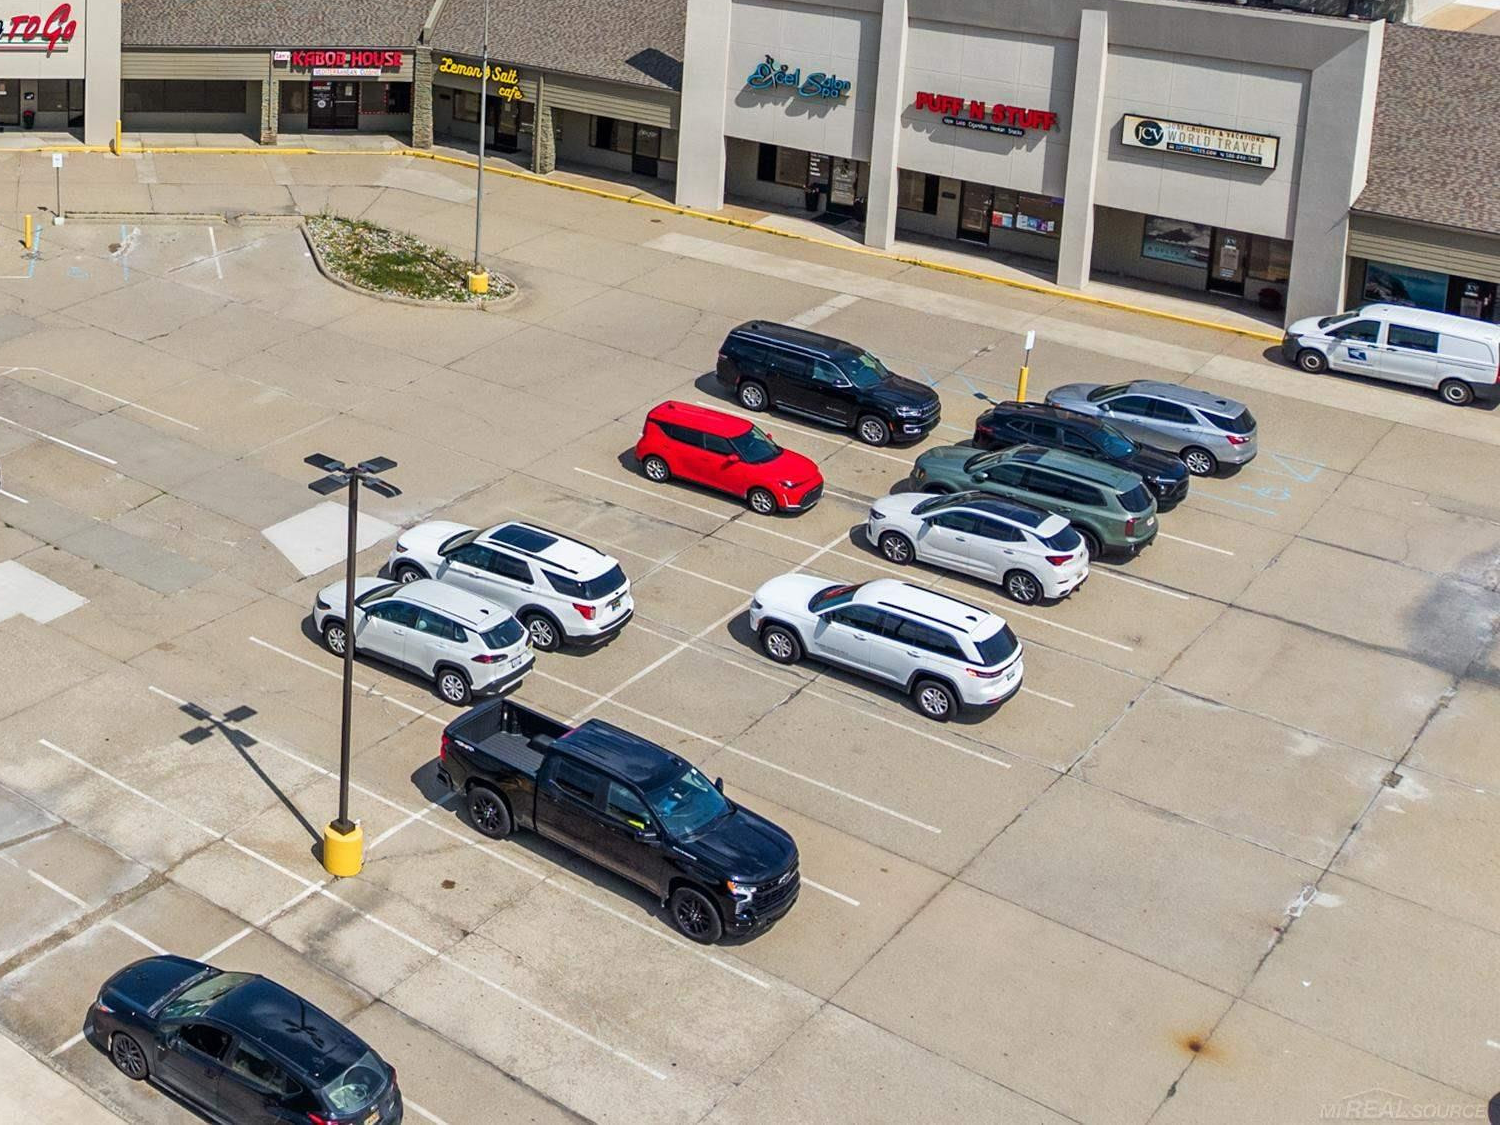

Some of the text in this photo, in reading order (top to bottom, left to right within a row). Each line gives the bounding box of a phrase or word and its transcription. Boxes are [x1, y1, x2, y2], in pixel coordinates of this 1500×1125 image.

[293, 51, 404, 67] KABOB HOUSE
[438, 56, 482, 79] Lemon
[491, 66, 519, 85] Salt
[498, 85, 524, 103] cafe
[799, 72, 852, 97] Salon
[915, 91, 1060, 131] PUFF N STUFF
[1137, 124, 1164, 142] JCV
[1167, 129, 1264, 155] WORLD TRAVEL
[1226, 132, 1266, 144] VACATIONS
